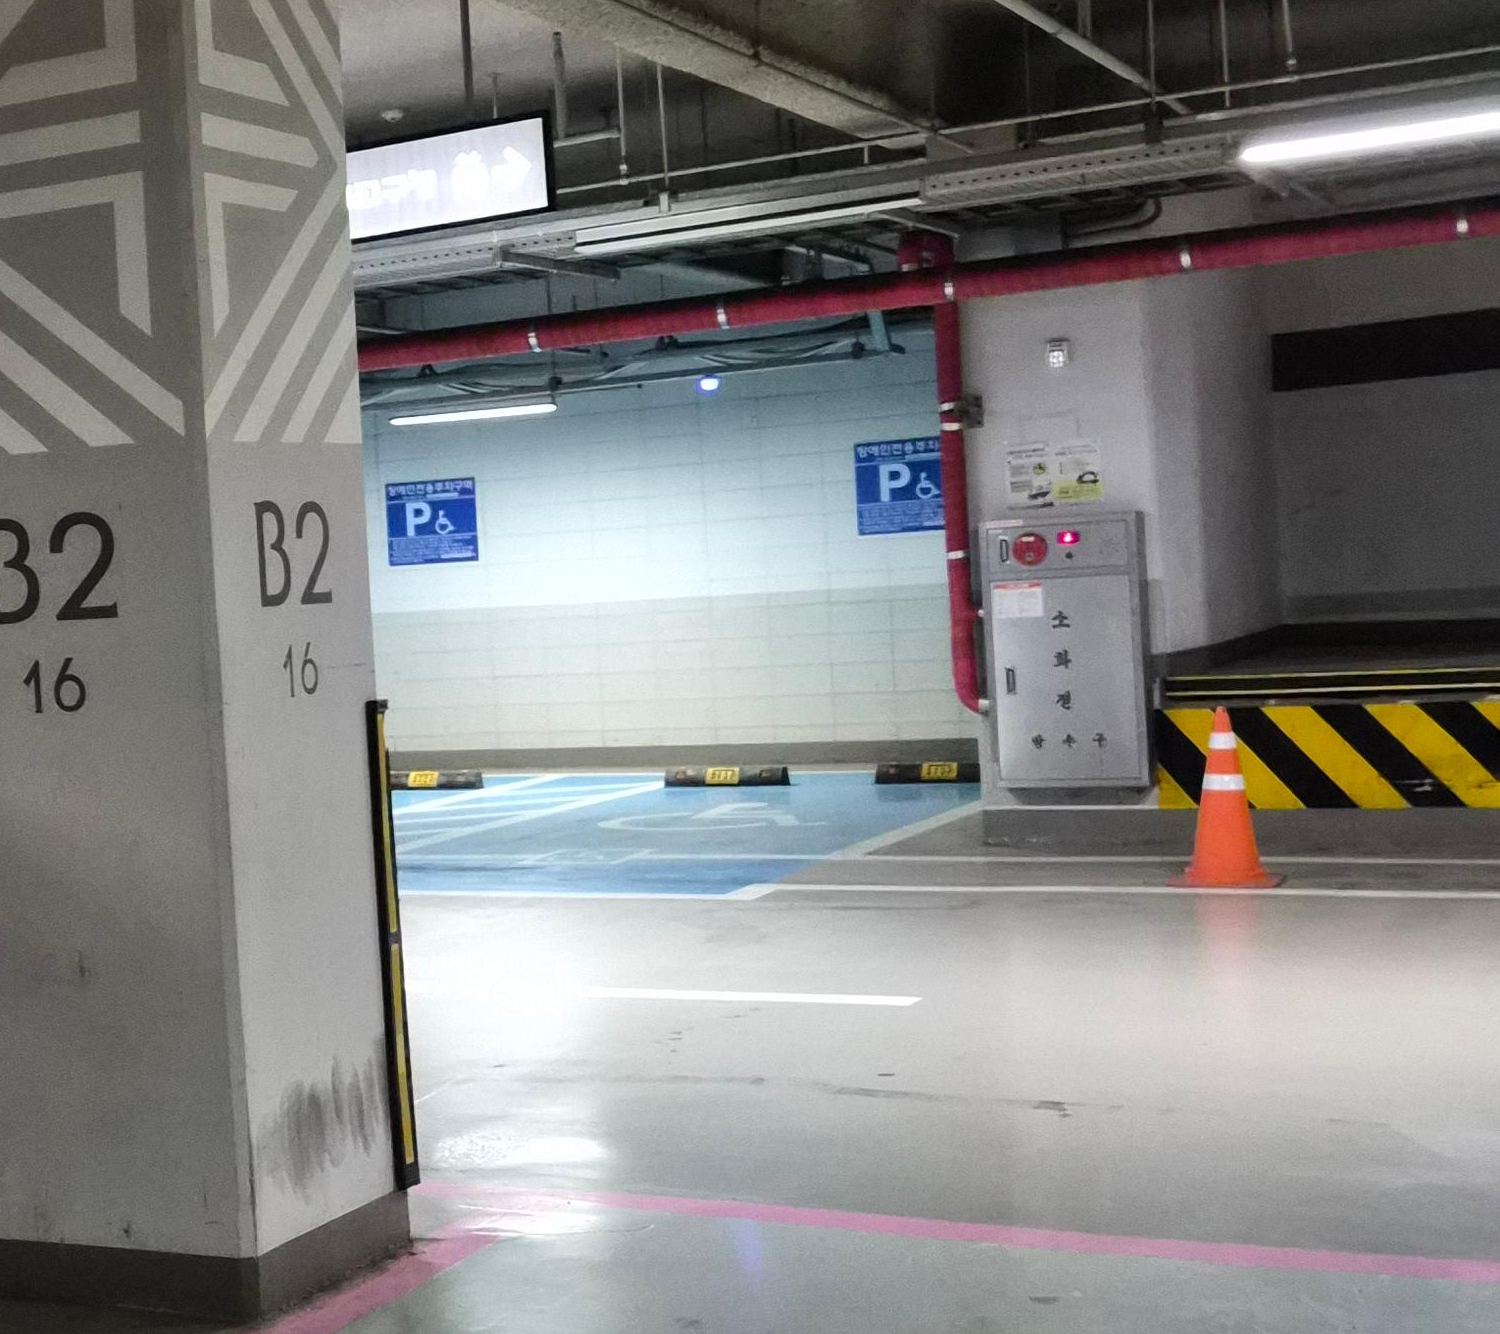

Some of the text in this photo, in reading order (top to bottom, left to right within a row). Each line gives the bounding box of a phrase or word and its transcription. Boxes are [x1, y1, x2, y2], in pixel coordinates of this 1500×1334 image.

[879, 464, 911, 502] P
[405, 502, 431, 536] P
[254, 500, 332, 607] B2
[23, 657, 86, 713] 16
[283, 642, 319, 697] 16
